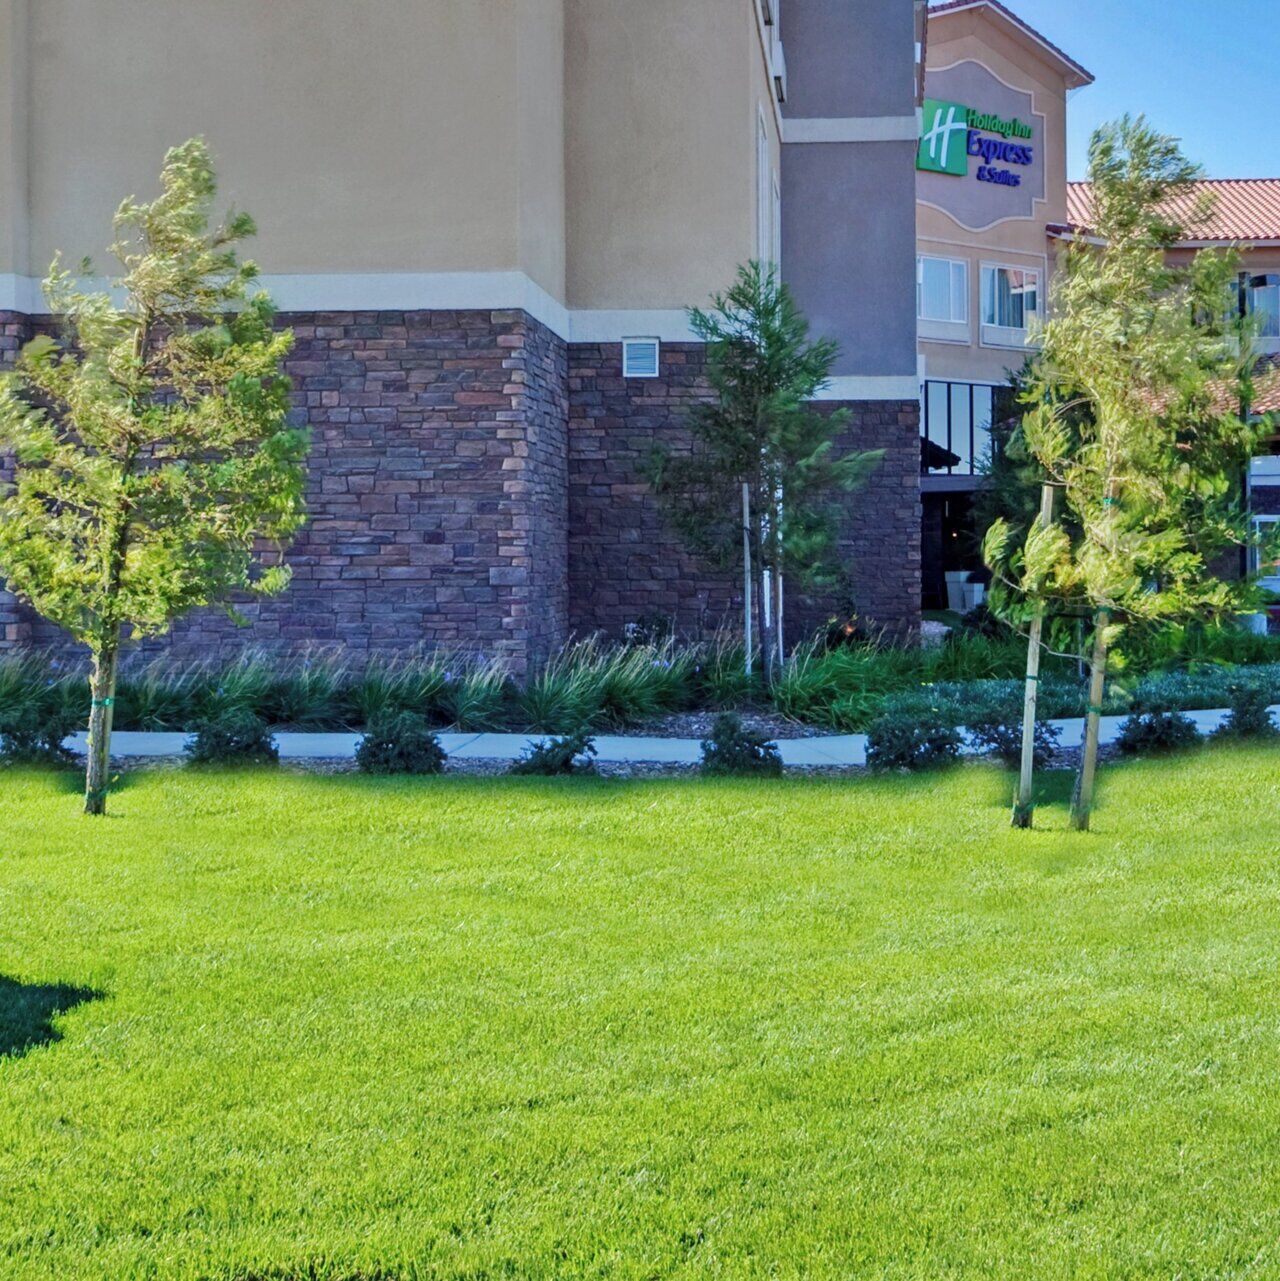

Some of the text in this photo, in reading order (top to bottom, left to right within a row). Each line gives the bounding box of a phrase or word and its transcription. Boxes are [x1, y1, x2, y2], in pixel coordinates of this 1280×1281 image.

[967, 108, 1032, 139] Holiday Inn
[967, 129, 1033, 166] Express
